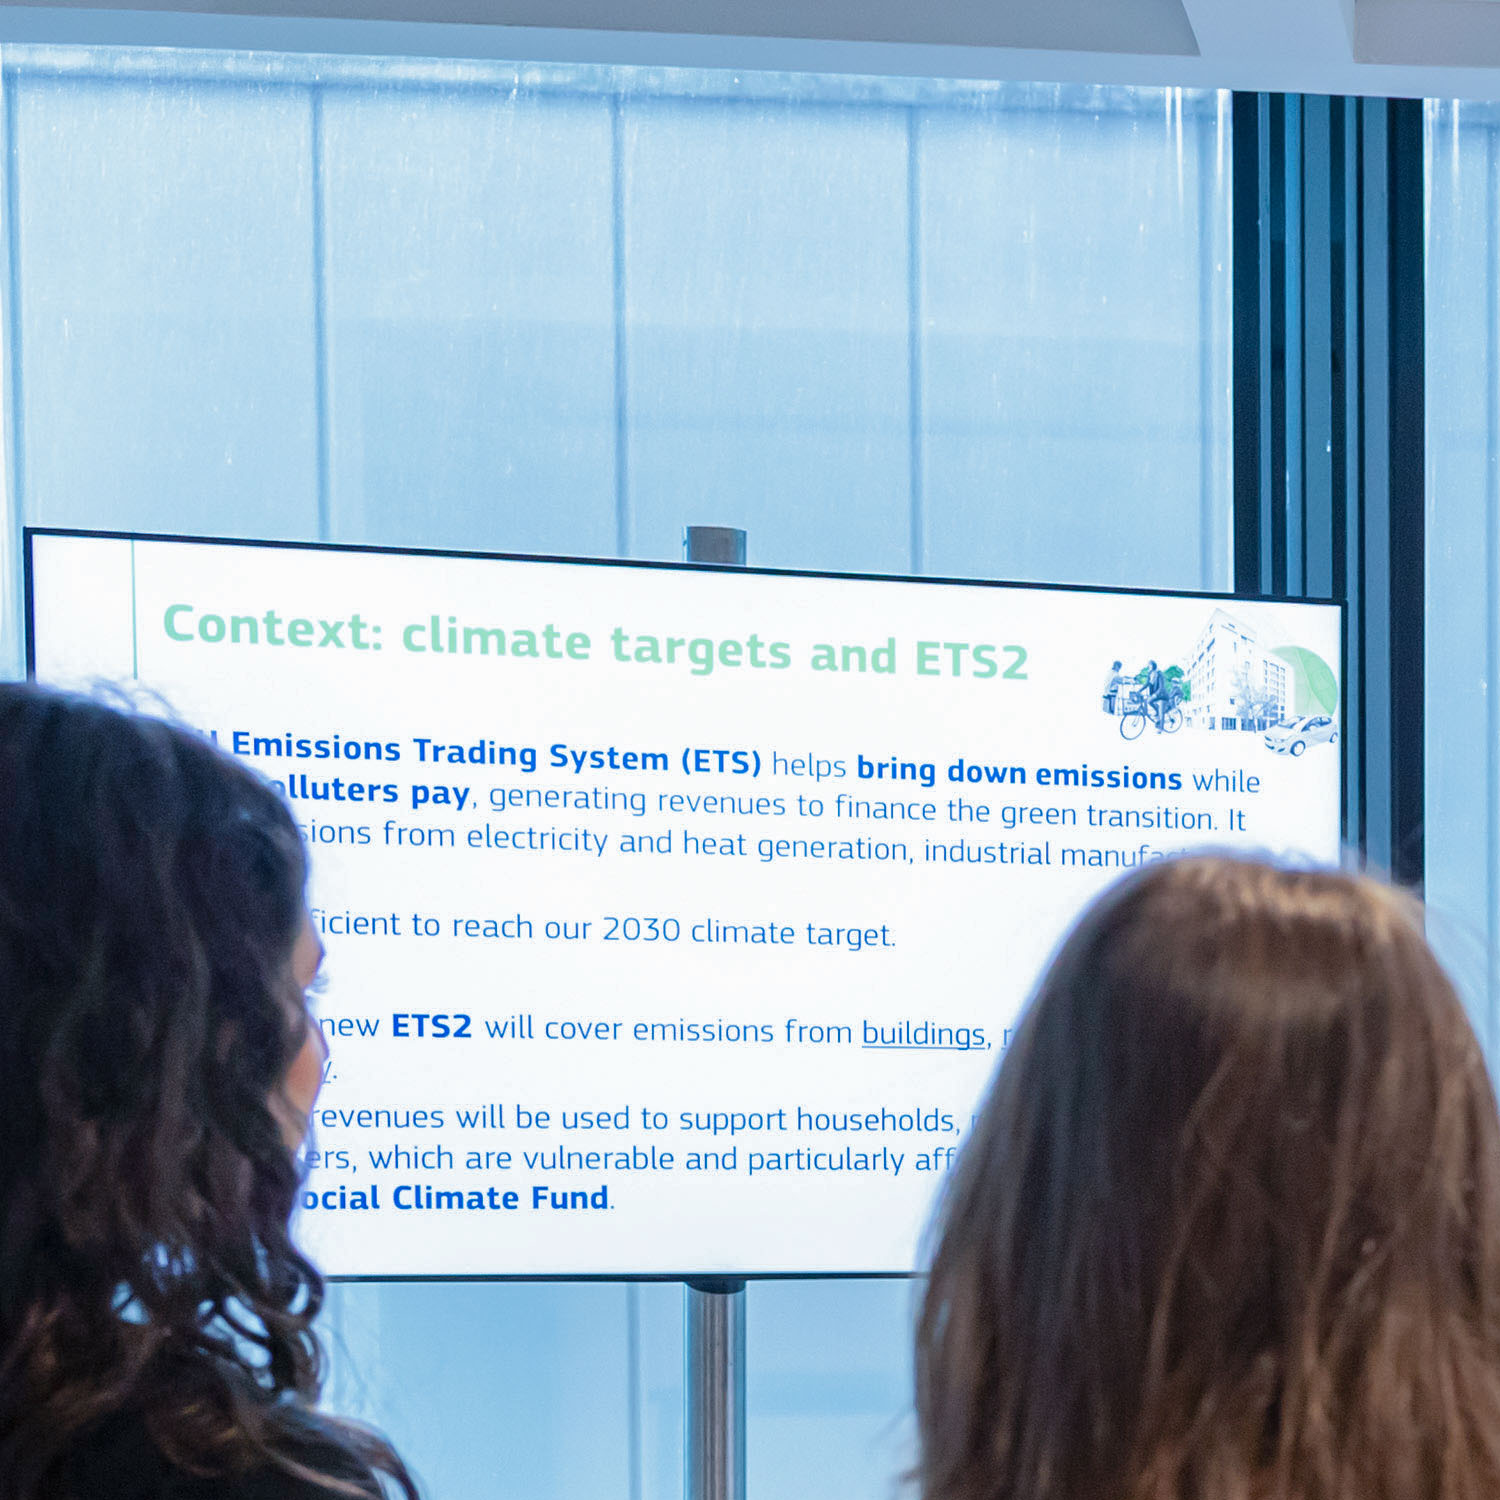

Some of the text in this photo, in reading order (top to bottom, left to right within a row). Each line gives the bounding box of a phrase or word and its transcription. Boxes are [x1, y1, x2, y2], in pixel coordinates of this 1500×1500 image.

[165, 605, 1026, 680] Context: climate targets and ETS2
[232, 731, 401, 762] Emissions
[413, 738, 536, 773] Trading
[550, 744, 668, 774] System
[682, 747, 760, 778] (ETS)
[774, 752, 846, 782] helps
[858, 754, 935, 788] bring
[948, 758, 1026, 784] down
[1036, 763, 1182, 790] emissions
[1192, 768, 1260, 793] while
[270, 774, 1246, 831] lluters pay, generating revenues to finance the green transition. It
[297, 819, 371, 844] sions
[384, 820, 454, 847] from
[468, 824, 608, 856] electricity
[620, 829, 671, 854] and
[684, 829, 746, 856] heat
[758, 837, 913, 864] generation,
[926, 839, 1051, 864] industrial
[311, 908, 895, 951] icient to reach our 2030 climate target.
[319, 1018, 380, 1037] new
[392, 1013, 472, 1038] ETS2
[485, 1014, 534, 1039] will
[546, 1022, 622, 1040] cover
[634, 1018, 774, 1042] emissions
[785, 1019, 851, 1044] from
[862, 1019, 991, 1051] buildings,
[456, 1104, 504, 1128] will
[517, 1104, 550, 1129] be
[562, 1104, 629, 1130] used
[641, 1107, 668, 1130] to
[680, 1108, 787, 1136] support
[797, 1106, 960, 1136] households,
[369, 1144, 453, 1170] which
[466, 1152, 512, 1170] are
[523, 1145, 674, 1170] vulnerable
[686, 1145, 736, 1171] and
[749, 1146, 904, 1176] particularly
[302, 1184, 614, 1210] ocial Climate Fund.
